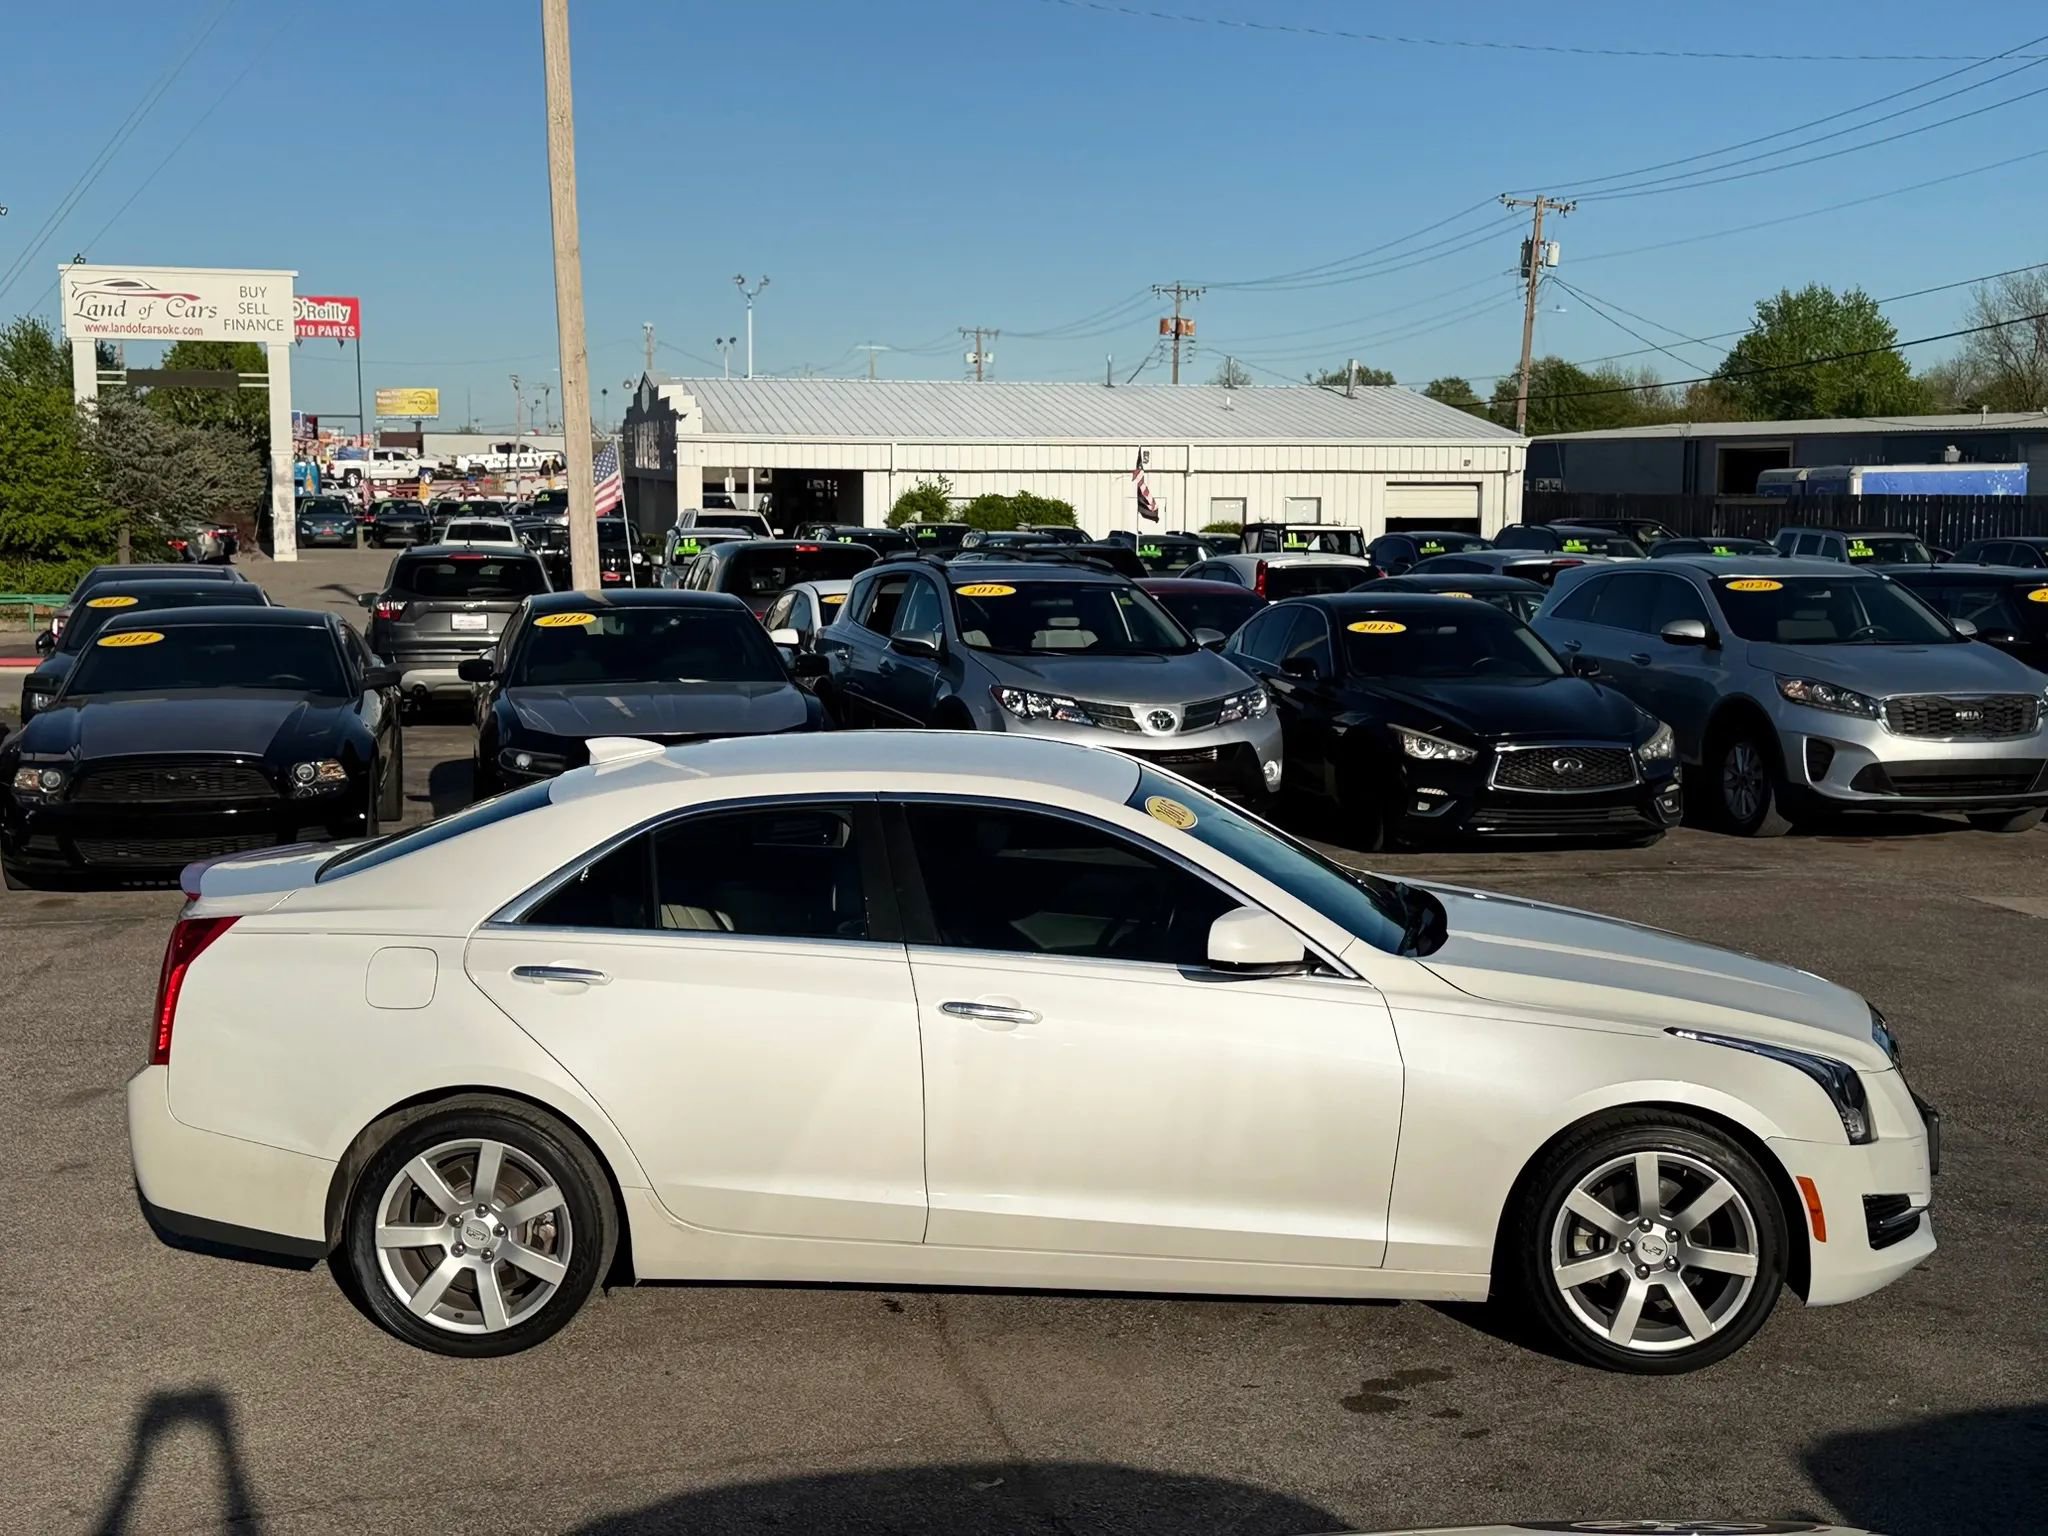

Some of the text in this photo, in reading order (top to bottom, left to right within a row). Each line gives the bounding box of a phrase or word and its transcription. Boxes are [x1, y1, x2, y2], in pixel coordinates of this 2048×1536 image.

[239, 285, 267, 298] BUY
[72, 295, 218, 321] Land of Cars
[238, 302, 270, 315] SELL
[84, 322, 204, 336] www.landofcarsokc.com
[223, 318, 285, 331] FINANCE
[318, 325, 356, 337] PARTS
[1737, 581, 1773, 589] 2020
[543, 614, 588, 626] 2019
[1358, 623, 1395, 632] 2018
